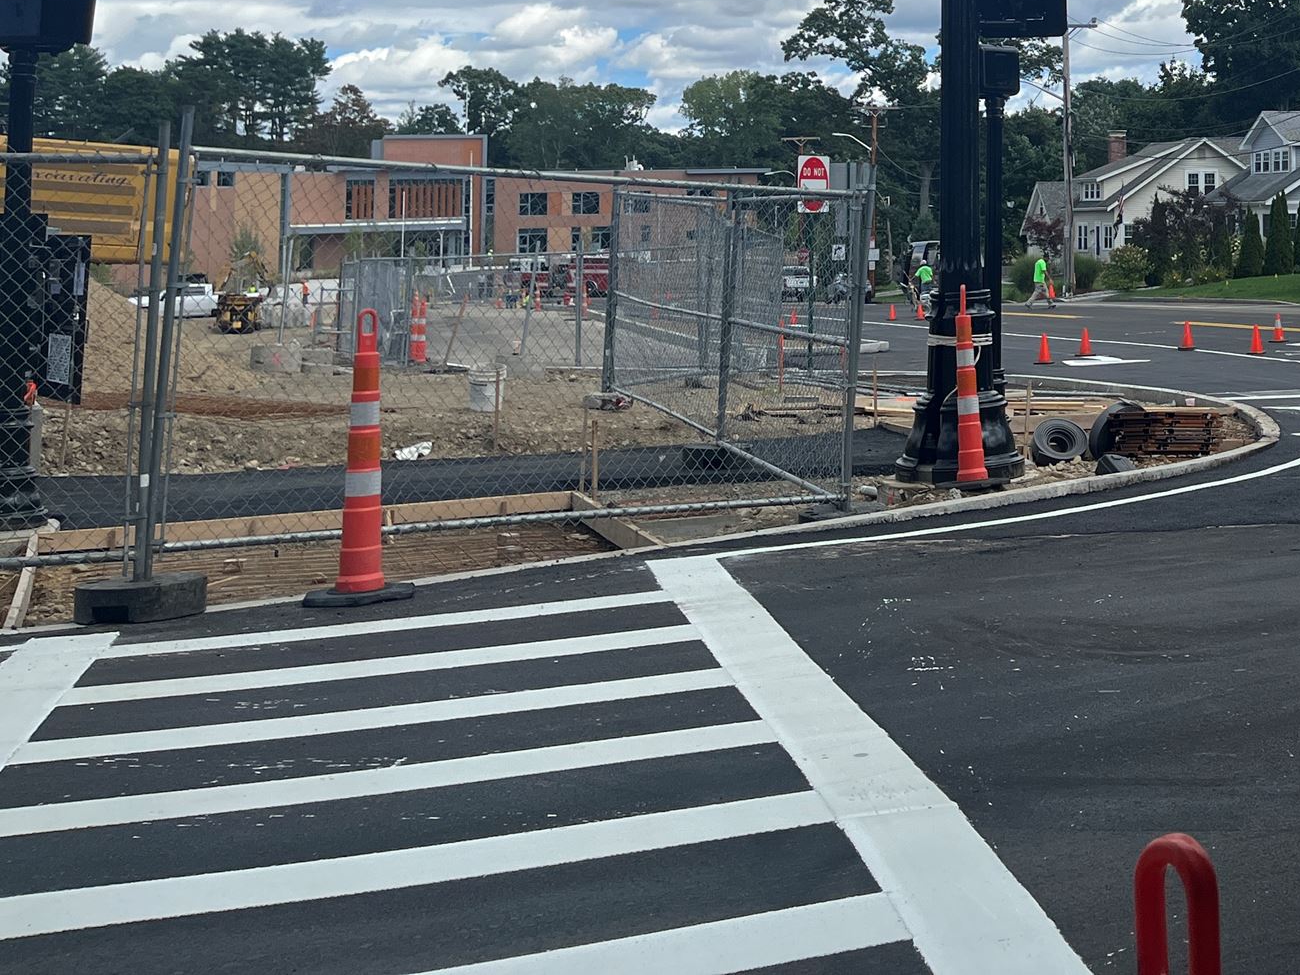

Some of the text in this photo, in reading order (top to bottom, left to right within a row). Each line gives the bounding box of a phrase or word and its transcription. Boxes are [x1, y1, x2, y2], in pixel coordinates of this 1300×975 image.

[803, 167, 825, 177] DO NOT
[35, 171, 128, 186] xcavating
